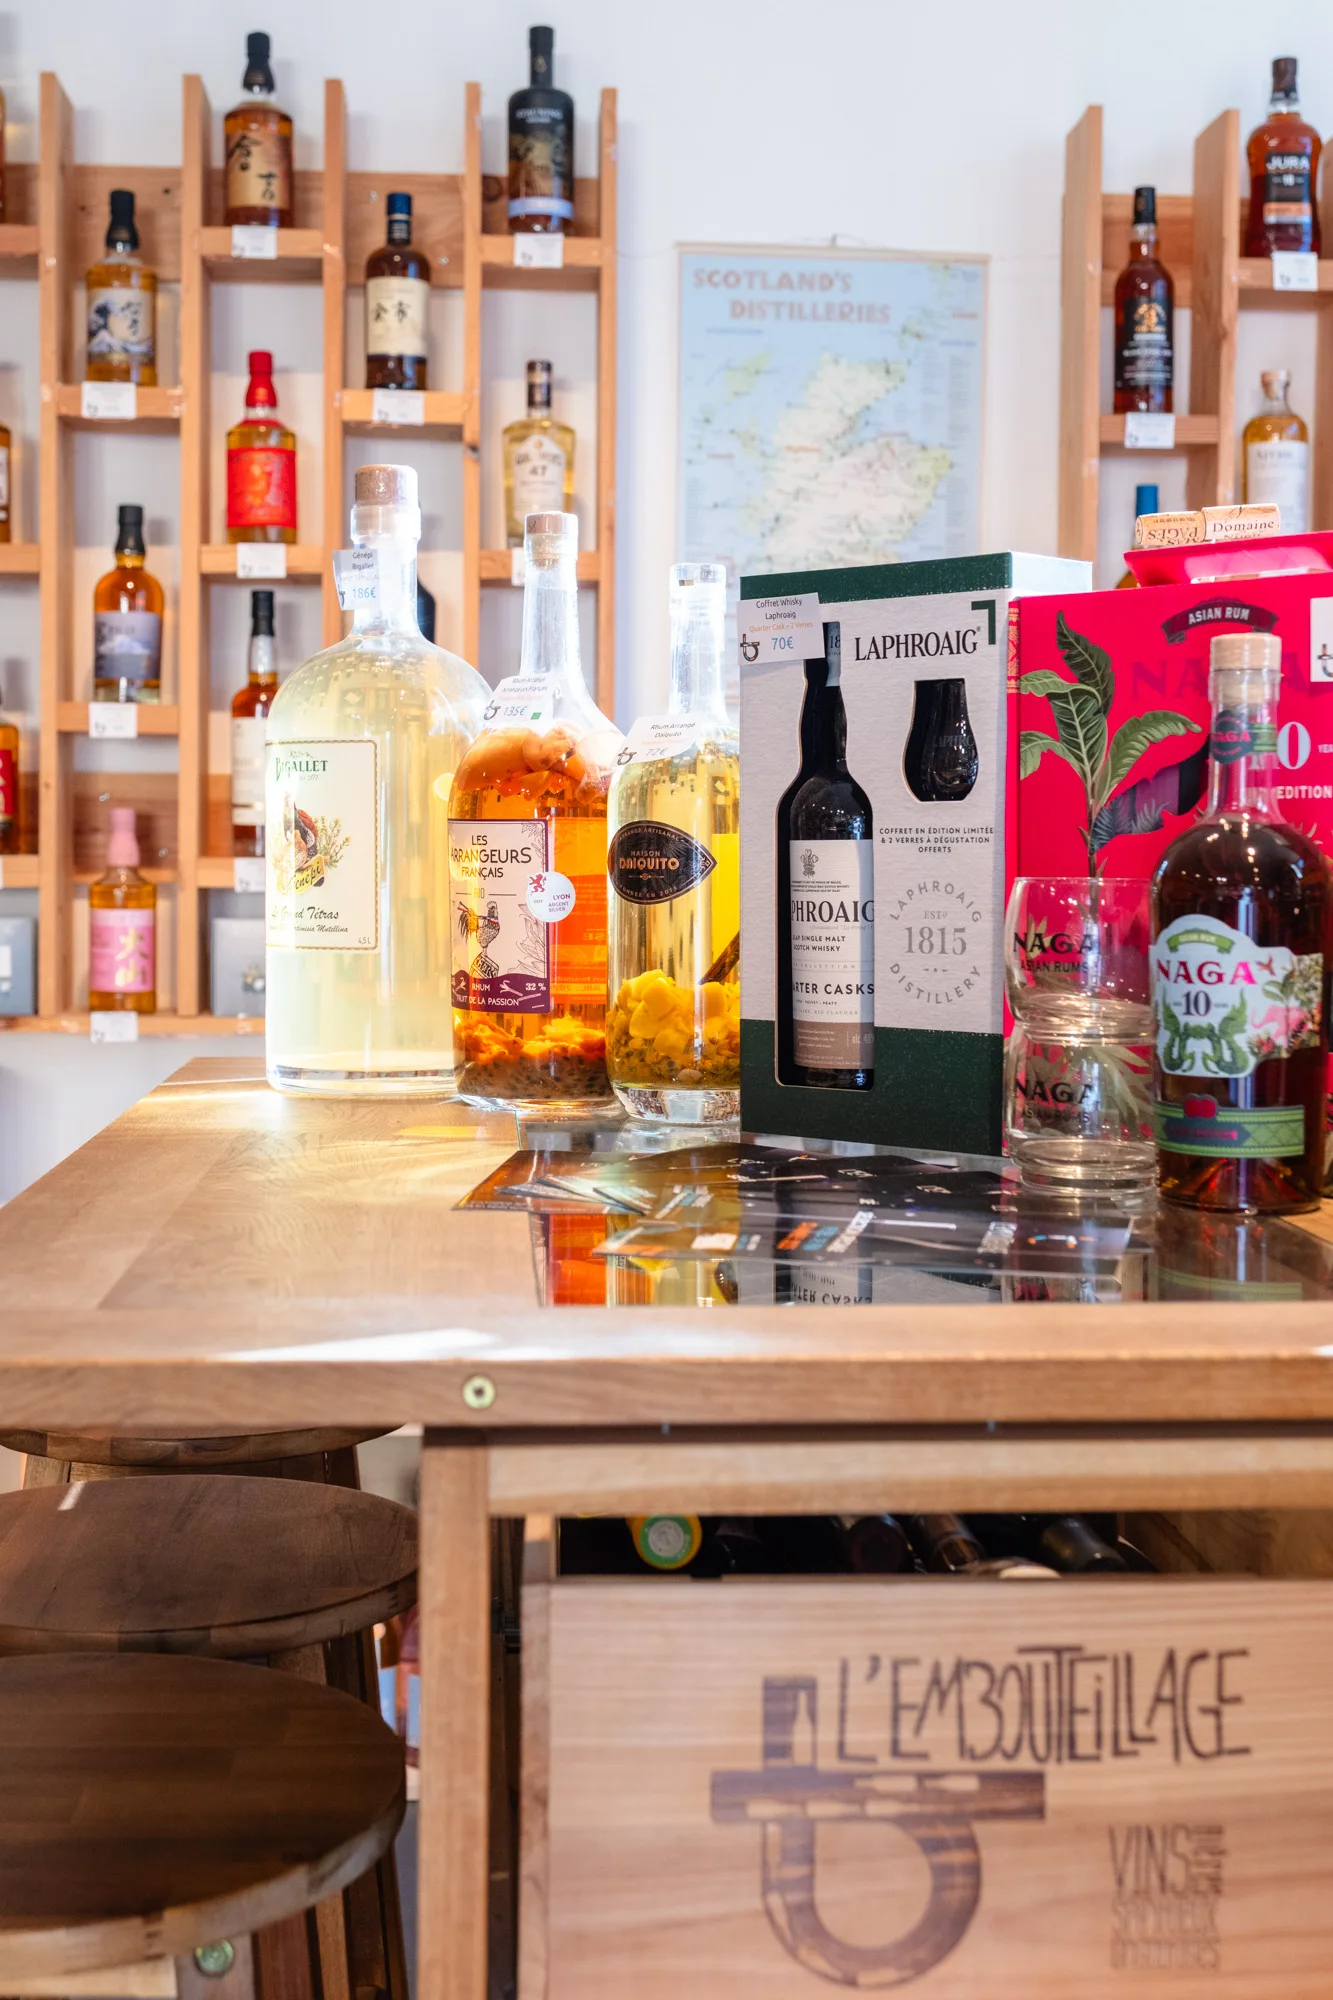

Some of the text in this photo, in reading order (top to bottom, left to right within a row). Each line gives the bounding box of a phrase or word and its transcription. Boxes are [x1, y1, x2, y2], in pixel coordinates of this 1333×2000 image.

[1266, 155, 1310, 170] JURA
[692, 268, 853, 293] SCOTLAND'S
[728, 299, 892, 323] DISTILLERIES
[1213, 520, 1275, 533] Domaine
[352, 551, 374, 560] Génépi
[351, 563, 375, 572] Bigallet
[352, 587, 376, 599] 186€
[756, 597, 803, 609] Coffret Whisky
[765, 611, 797, 620] Laphroaig
[1188, 606, 1250, 625] ASIAN RUM
[749, 624, 772, 633] Quarter
[771, 636, 794, 650] 70€
[855, 629, 978, 661] LAPHROAIG
[1132, 652, 1309, 700] NAA
[503, 705, 527, 716] 135€
[650, 722, 696, 730] Rhum Arrangé
[275, 757, 329, 782] BIGALLET
[928, 826, 960, 834] ÉDITION
[963, 826, 994, 834] LIMITÉE
[471, 835, 488, 846] LES
[934, 836, 990, 844] DÉGUSTATION
[451, 847, 532, 864] ARRANGEURS
[619, 857, 680, 870] DAIQUITO
[461, 867, 504, 881] FRANÇAIS
[890, 880, 982, 922] LAPHROAIG
[306, 905, 340, 920] Tétras
[316, 923, 349, 934] Mutellina
[904, 926, 967, 956] 1815
[1013, 932, 1102, 955] NAGA
[1156, 960, 1257, 985] NAGA
[471, 983, 491, 992] RHUM
[525, 982, 537, 991] 32
[537, 983, 547, 991] %
[824, 983, 875, 995] CASKS
[890, 963, 981, 1004] DISTILLERY
[468, 996, 477, 1005] DE
[477, 997, 486, 1005] LA
[487, 997, 519, 1007] PASSION
[1182, 990, 1212, 1017] 10
[1107, 1823, 1190, 1899] VINS
